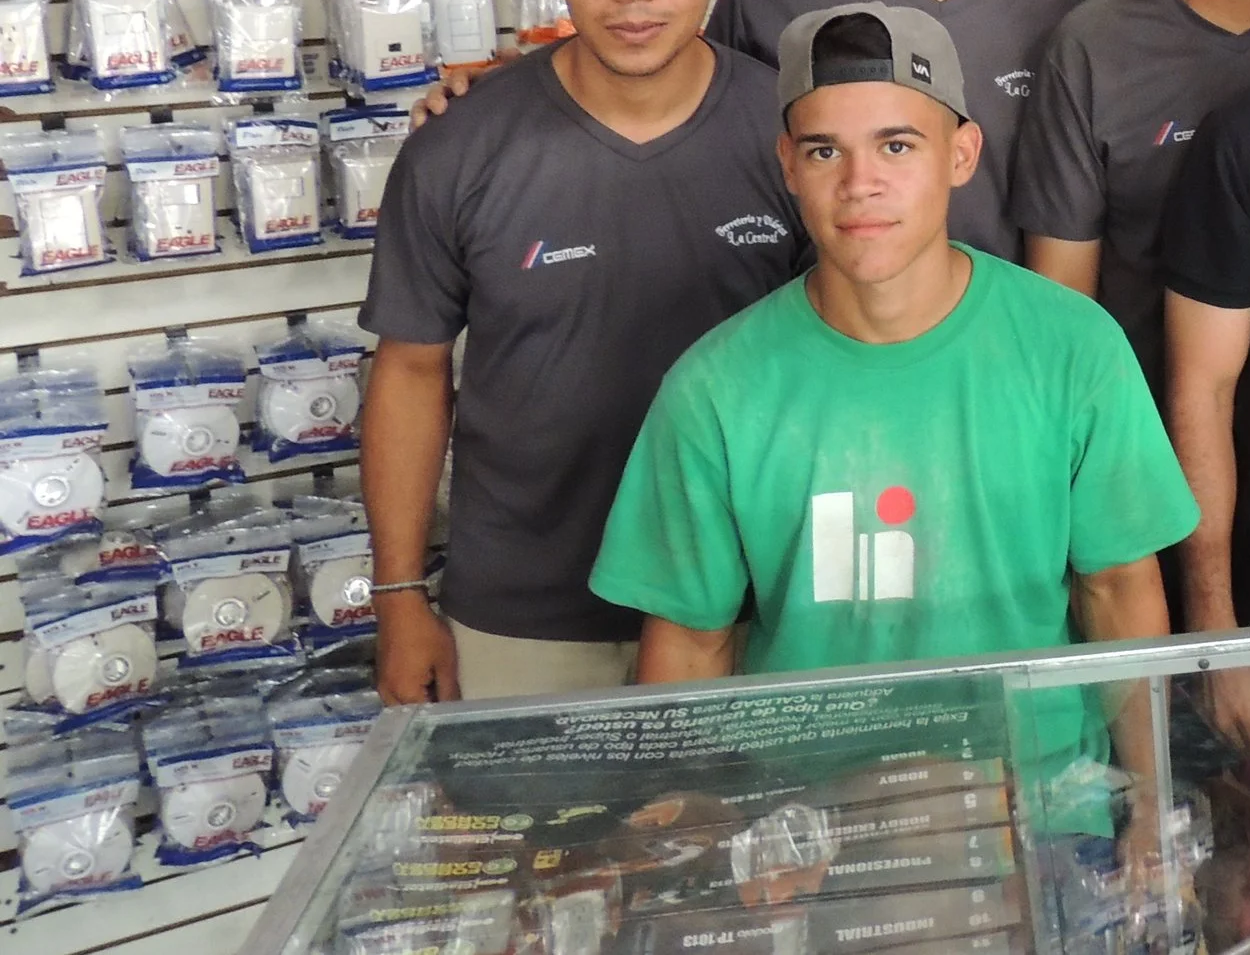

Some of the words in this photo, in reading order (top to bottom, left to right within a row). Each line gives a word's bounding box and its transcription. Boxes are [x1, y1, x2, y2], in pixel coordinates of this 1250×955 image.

[0, 60, 39, 75] AGLE
[235, 58, 285, 73] EAGLE
[380, 54, 424, 71] EAGLE
[174, 157, 218, 175] EAGLE
[56, 168, 105, 185] EAGLE
[265, 215, 312, 232] EAGLE
[155, 234, 210, 252] EAGLE
[745, 231, 778, 244] Central
[41, 245, 99, 265] EAGLE
[543, 245, 596, 264] CEMEX
[208, 387, 245, 399] EAGLE
[27, 508, 94, 529] EAGLE
[111, 602, 149, 619] EAGLE
[331, 607, 375, 623] EAGL
[201, 627, 264, 649] EAGLE
[827, 688, 893, 700] Adquiera
[693, 702, 727, 714] para
[730, 696, 805, 709] CALIDAD
[782, 703, 818, 713] tipo
[663, 708, 688, 718] SU
[752, 707, 776, 717] de
[934, 712, 968, 723] Exija
[671, 711, 745, 729] usuario
[916, 717, 928, 726] la
[564, 722, 636, 733] usted?
[640, 728, 712, 740] Industrial
[821, 719, 911, 738] herramienta
[683, 735, 718, 747] para
[788, 731, 816, 743] que
[604, 742, 634, 751] tipo
[639, 742, 678, 750] cada
[739, 737, 783, 752] usted
[546, 753, 602, 761] niveles
[607, 752, 630, 761] los
[669, 745, 735, 759] necesita
[878, 771, 928, 785] HOBBY
[963, 770, 974, 780] 4
[965, 793, 977, 808] 5
[827, 856, 931, 875] PROFESIONAL
[836, 917, 934, 941] INDUSTRIAL
[684, 934, 715, 947] 1013
[717, 931, 734, 943] TP
